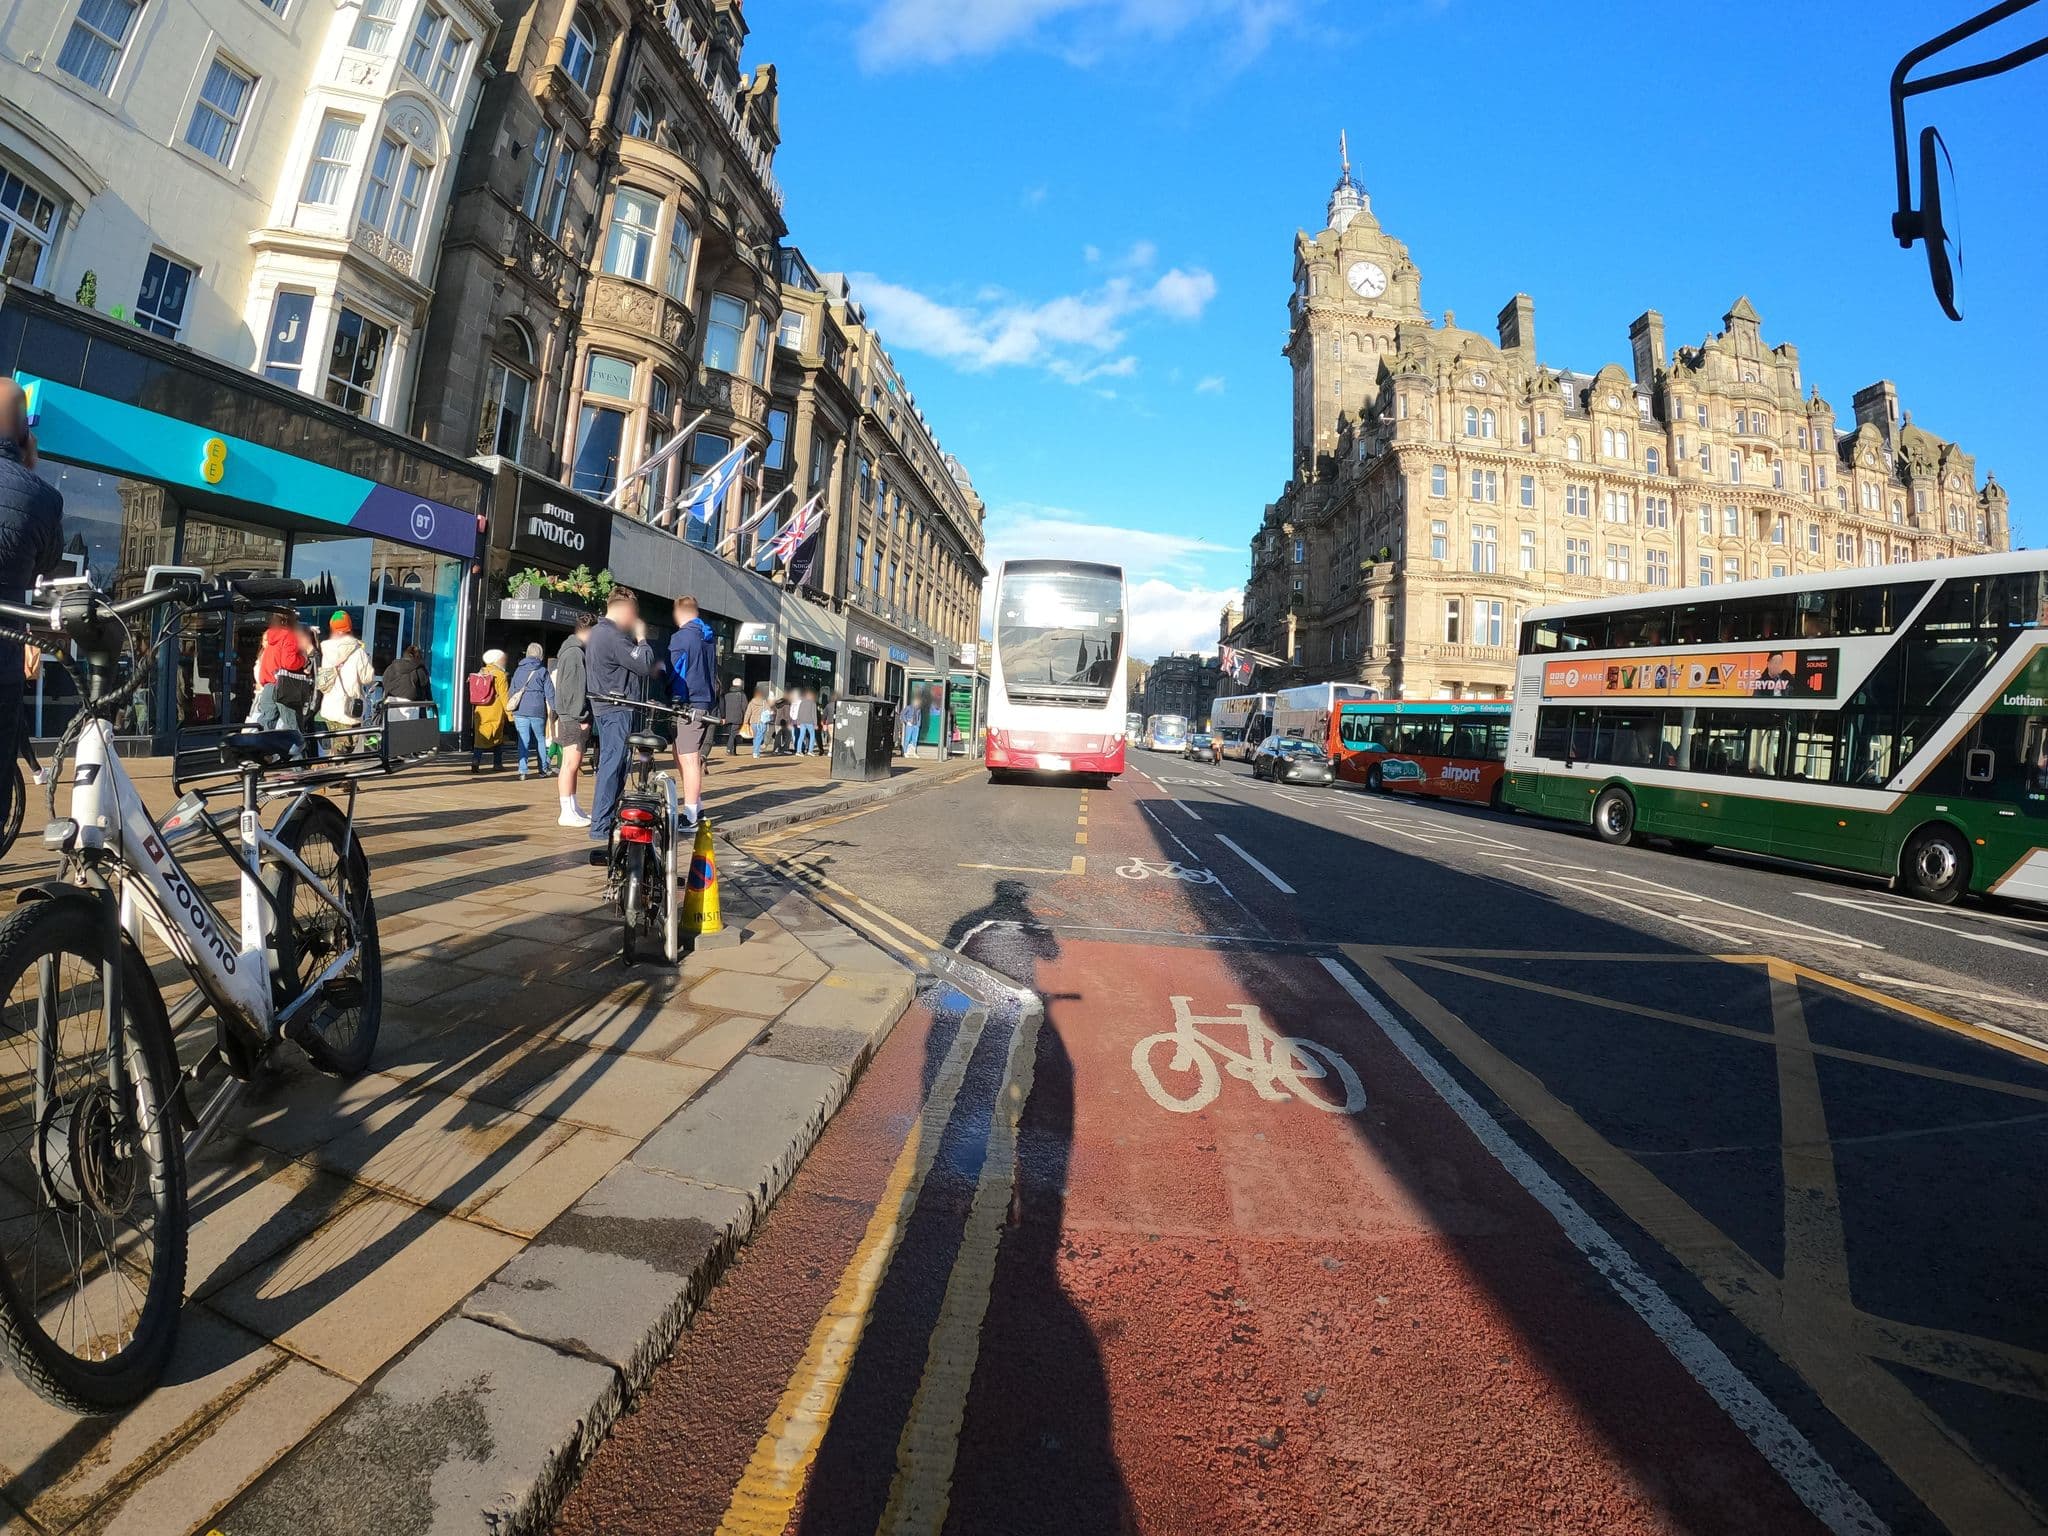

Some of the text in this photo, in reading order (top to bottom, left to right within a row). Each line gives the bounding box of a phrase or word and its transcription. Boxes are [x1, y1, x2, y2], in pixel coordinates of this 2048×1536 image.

[416, 514, 431, 530] BT
[543, 503, 576, 525] HOTEL
[528, 516, 585, 551] INDIGO
[1582, 673, 1603, 682] MAKE
[1688, 663, 1738, 690] DAY
[1738, 669, 1762, 679] LESS
[1736, 680, 1790, 690] EVERYDAY
[1441, 761, 1480, 783] airport
